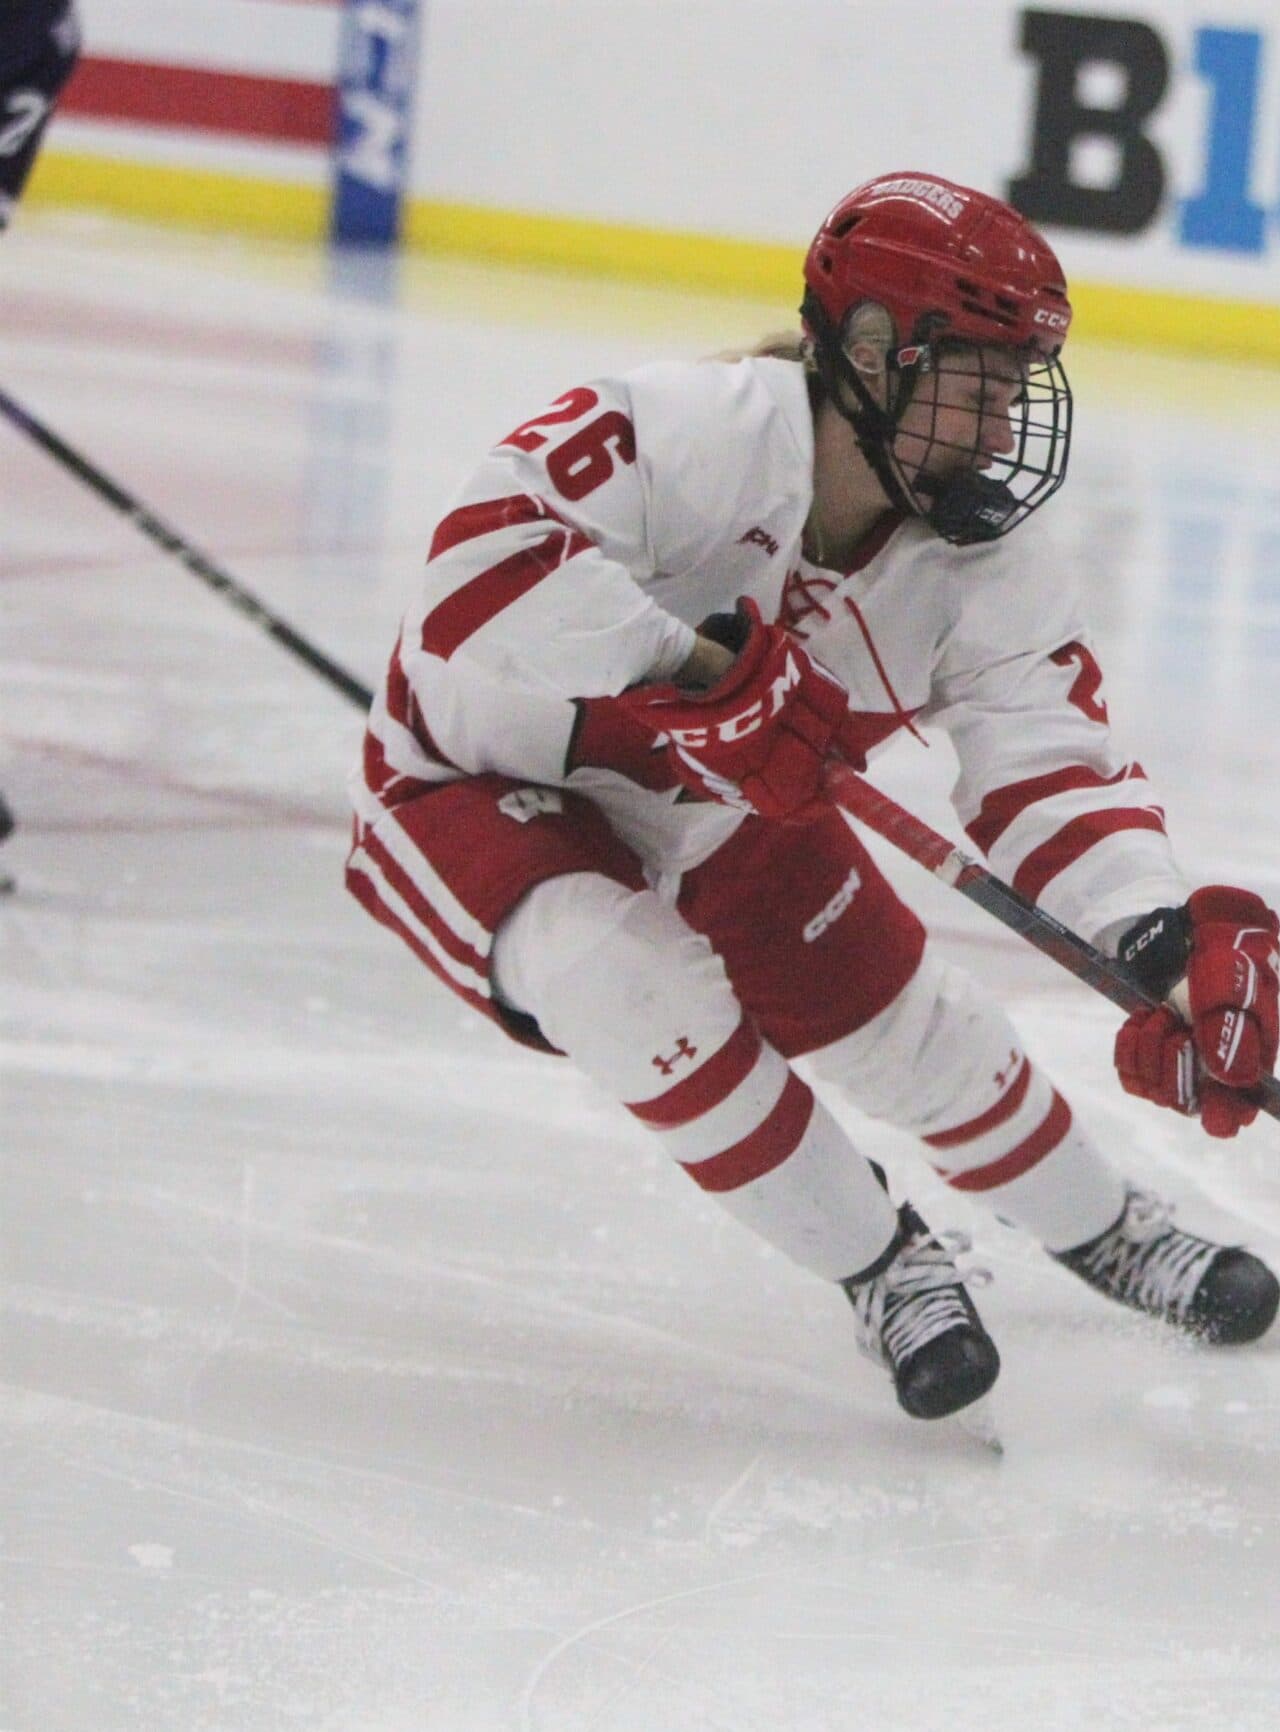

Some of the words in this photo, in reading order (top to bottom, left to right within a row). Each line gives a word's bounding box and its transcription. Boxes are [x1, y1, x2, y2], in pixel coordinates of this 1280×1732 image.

[494, 386, 637, 503] 26
[669, 650, 801, 748] CCM
[802, 865, 863, 944] CCM
[1124, 919, 1165, 962] CCM
[1216, 1010, 1236, 1061] CCM
